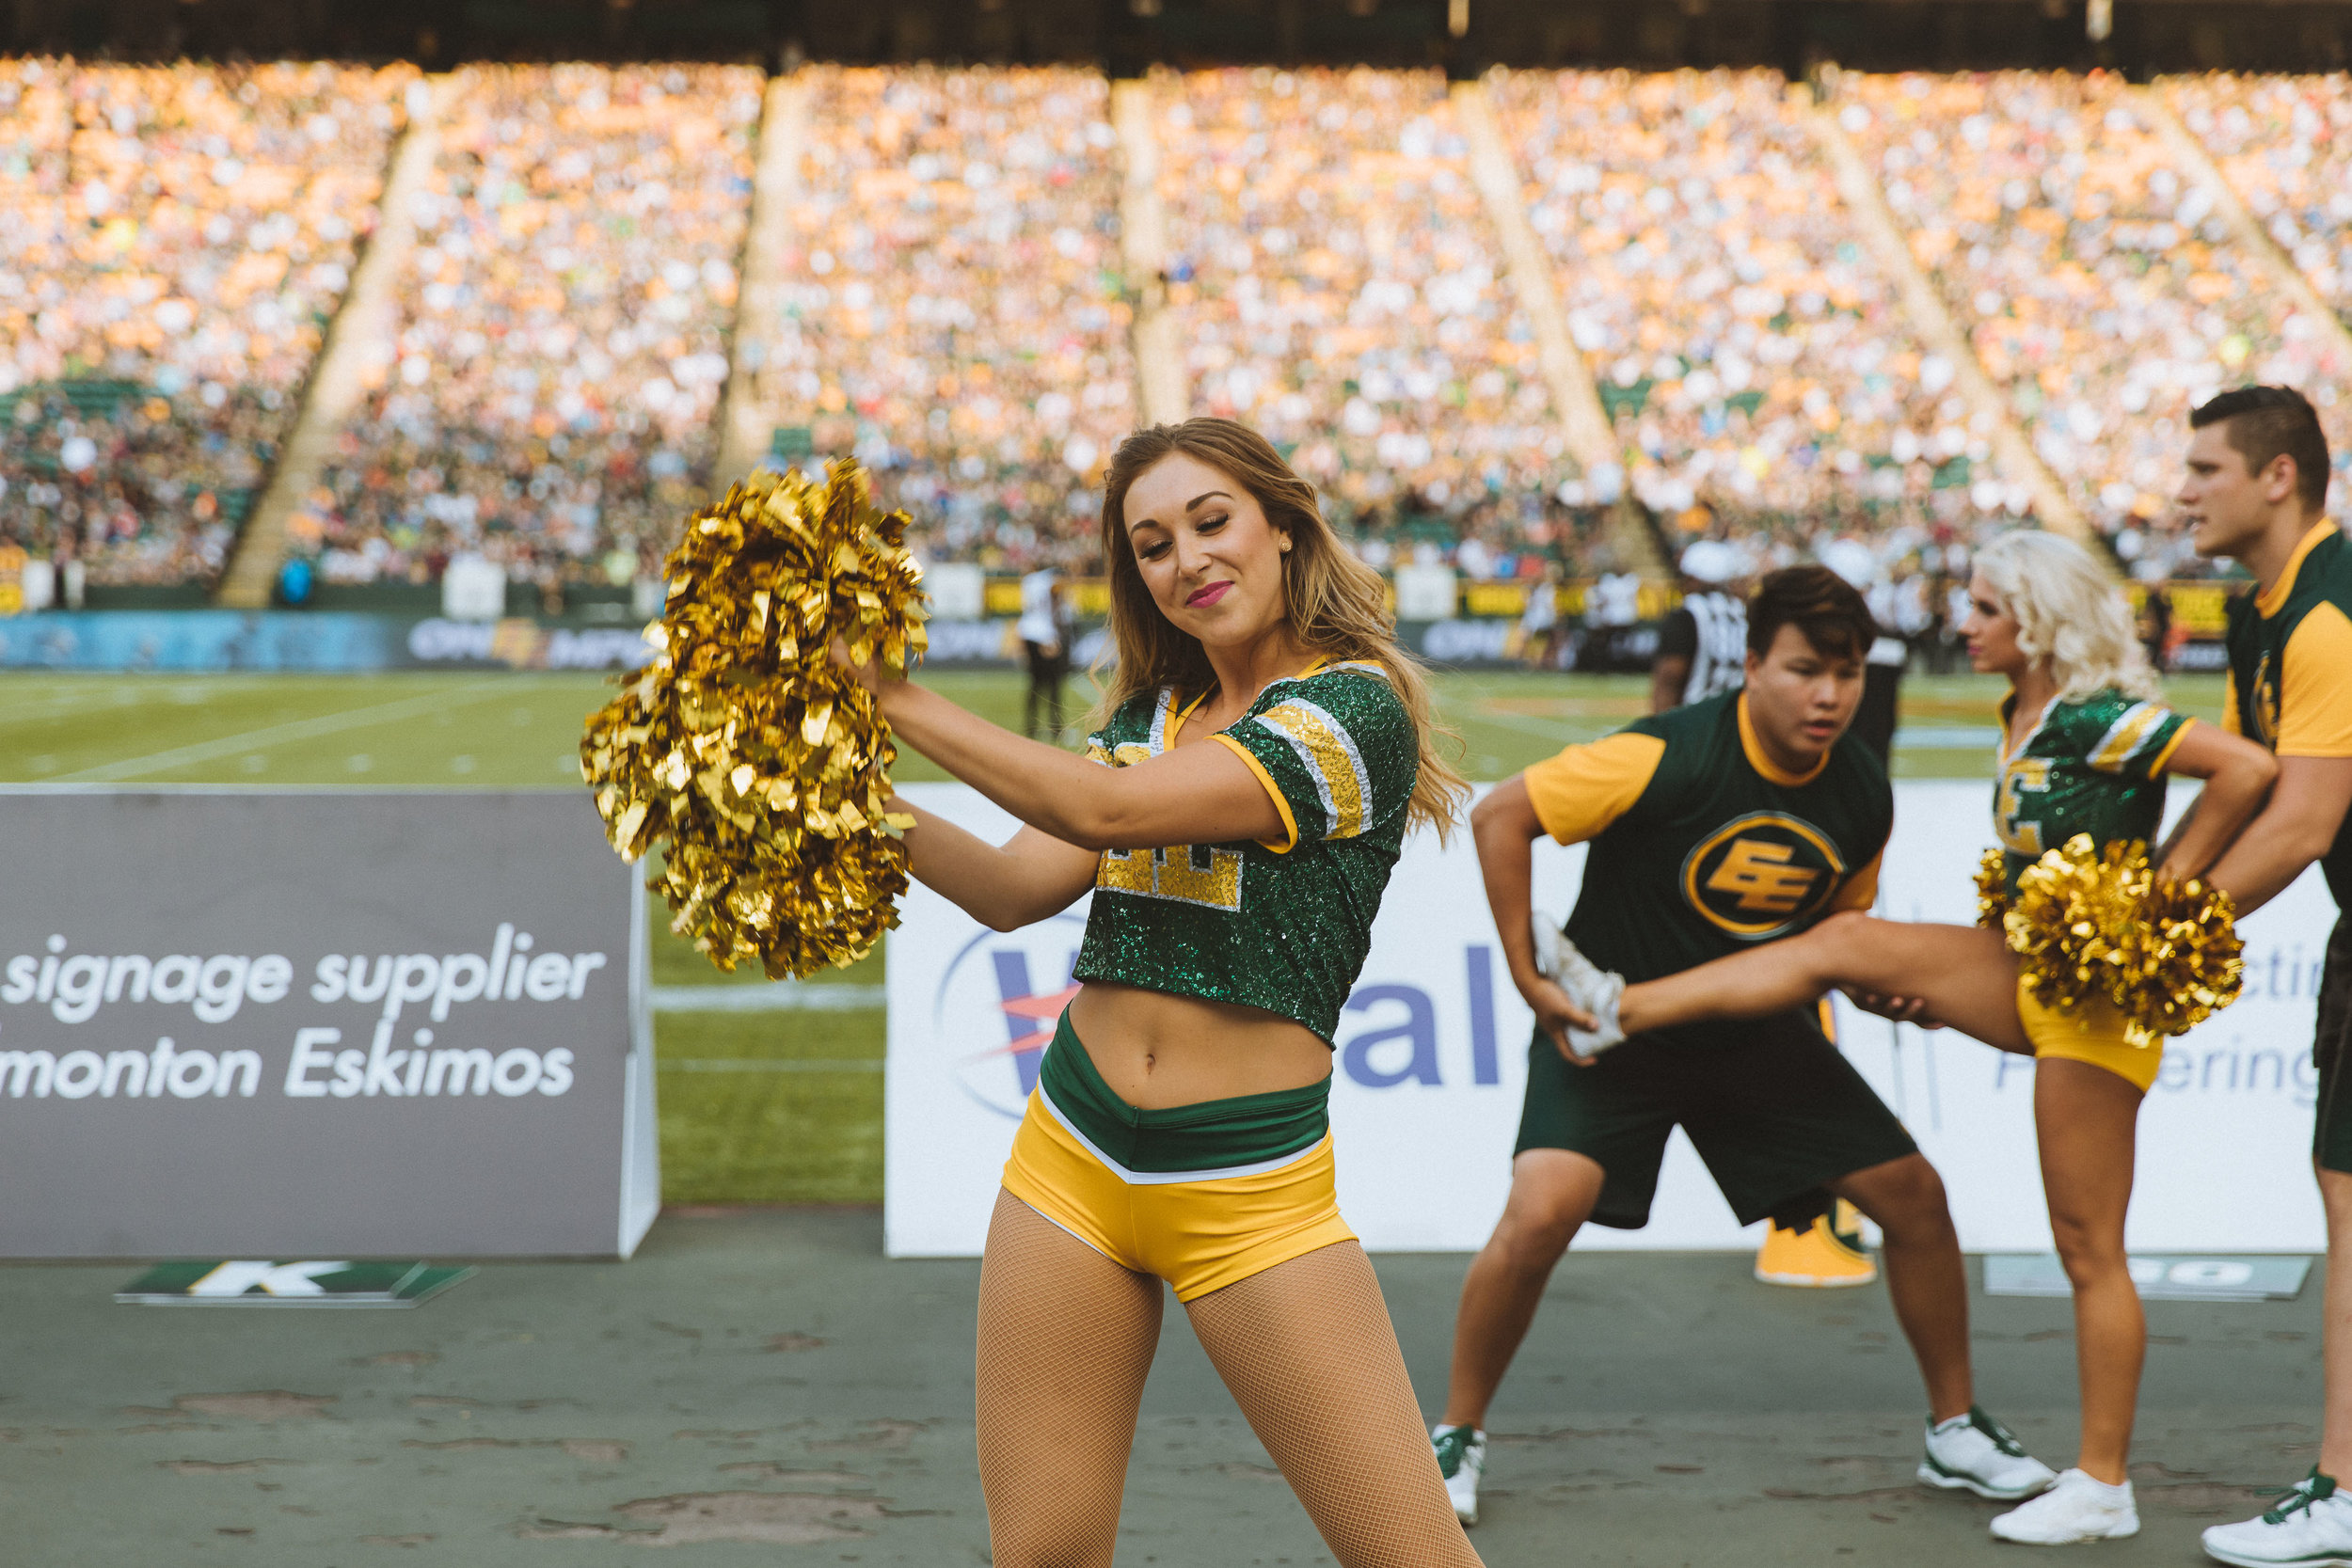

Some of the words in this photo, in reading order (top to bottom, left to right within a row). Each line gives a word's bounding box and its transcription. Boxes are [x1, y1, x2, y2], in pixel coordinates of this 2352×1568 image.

[0, 932, 294, 1024] signage
[310, 923, 607, 1022] supplier
[0, 1037, 262, 1099] monton
[283, 1019, 574, 1099] Eskimos
